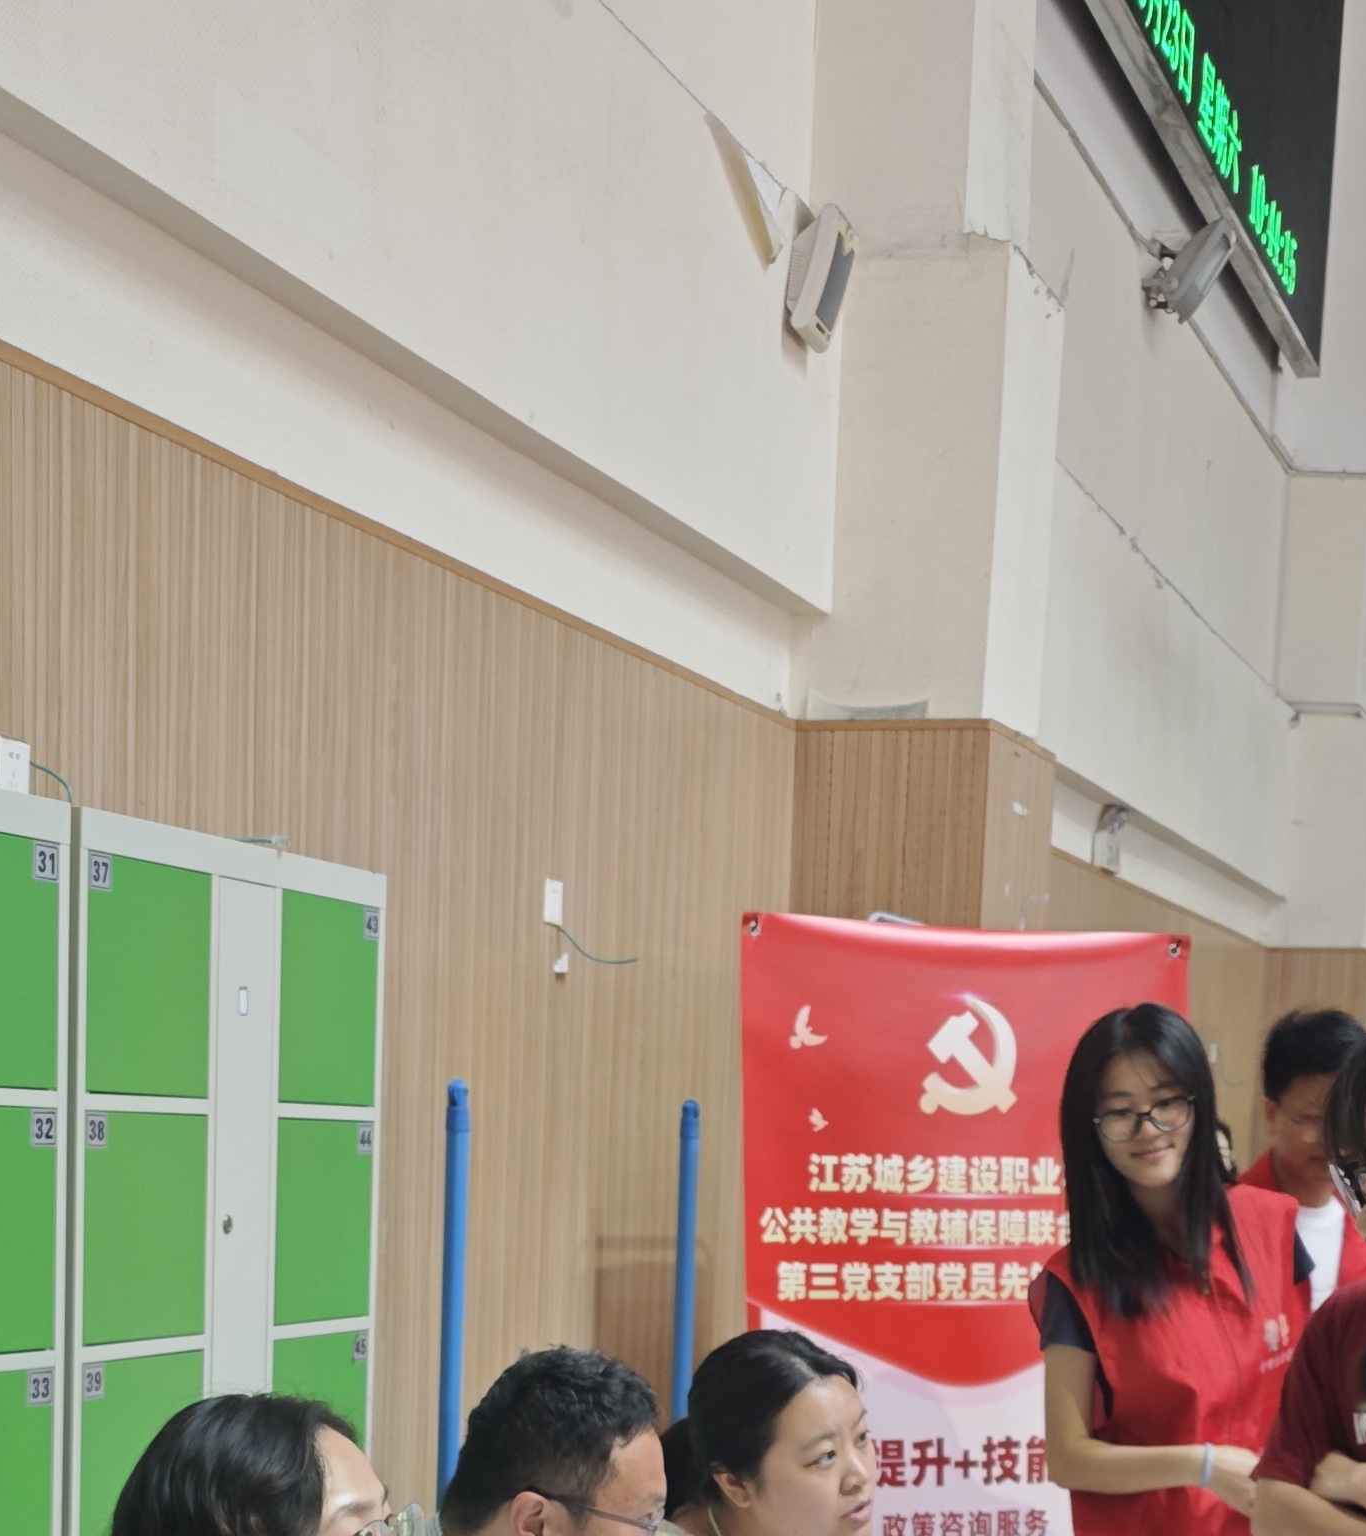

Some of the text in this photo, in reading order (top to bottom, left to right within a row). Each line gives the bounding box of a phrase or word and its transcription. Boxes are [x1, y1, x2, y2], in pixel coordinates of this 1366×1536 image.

[1198, 52, 1242, 194] 星期六
[37, 851, 57, 874] 31
[92, 861, 109, 883] 37
[366, 916, 378, 933] 43
[34, 1118, 54, 1141] 32
[89, 1119, 105, 1141] 38
[359, 1130, 371, 1146] 44
[809, 1153, 1066, 1194] 江苏城乡建设职业
[354, 1340, 366, 1355] 45
[32, 1377, 49, 1398] 33
[87, 1372, 102, 1392] 39
